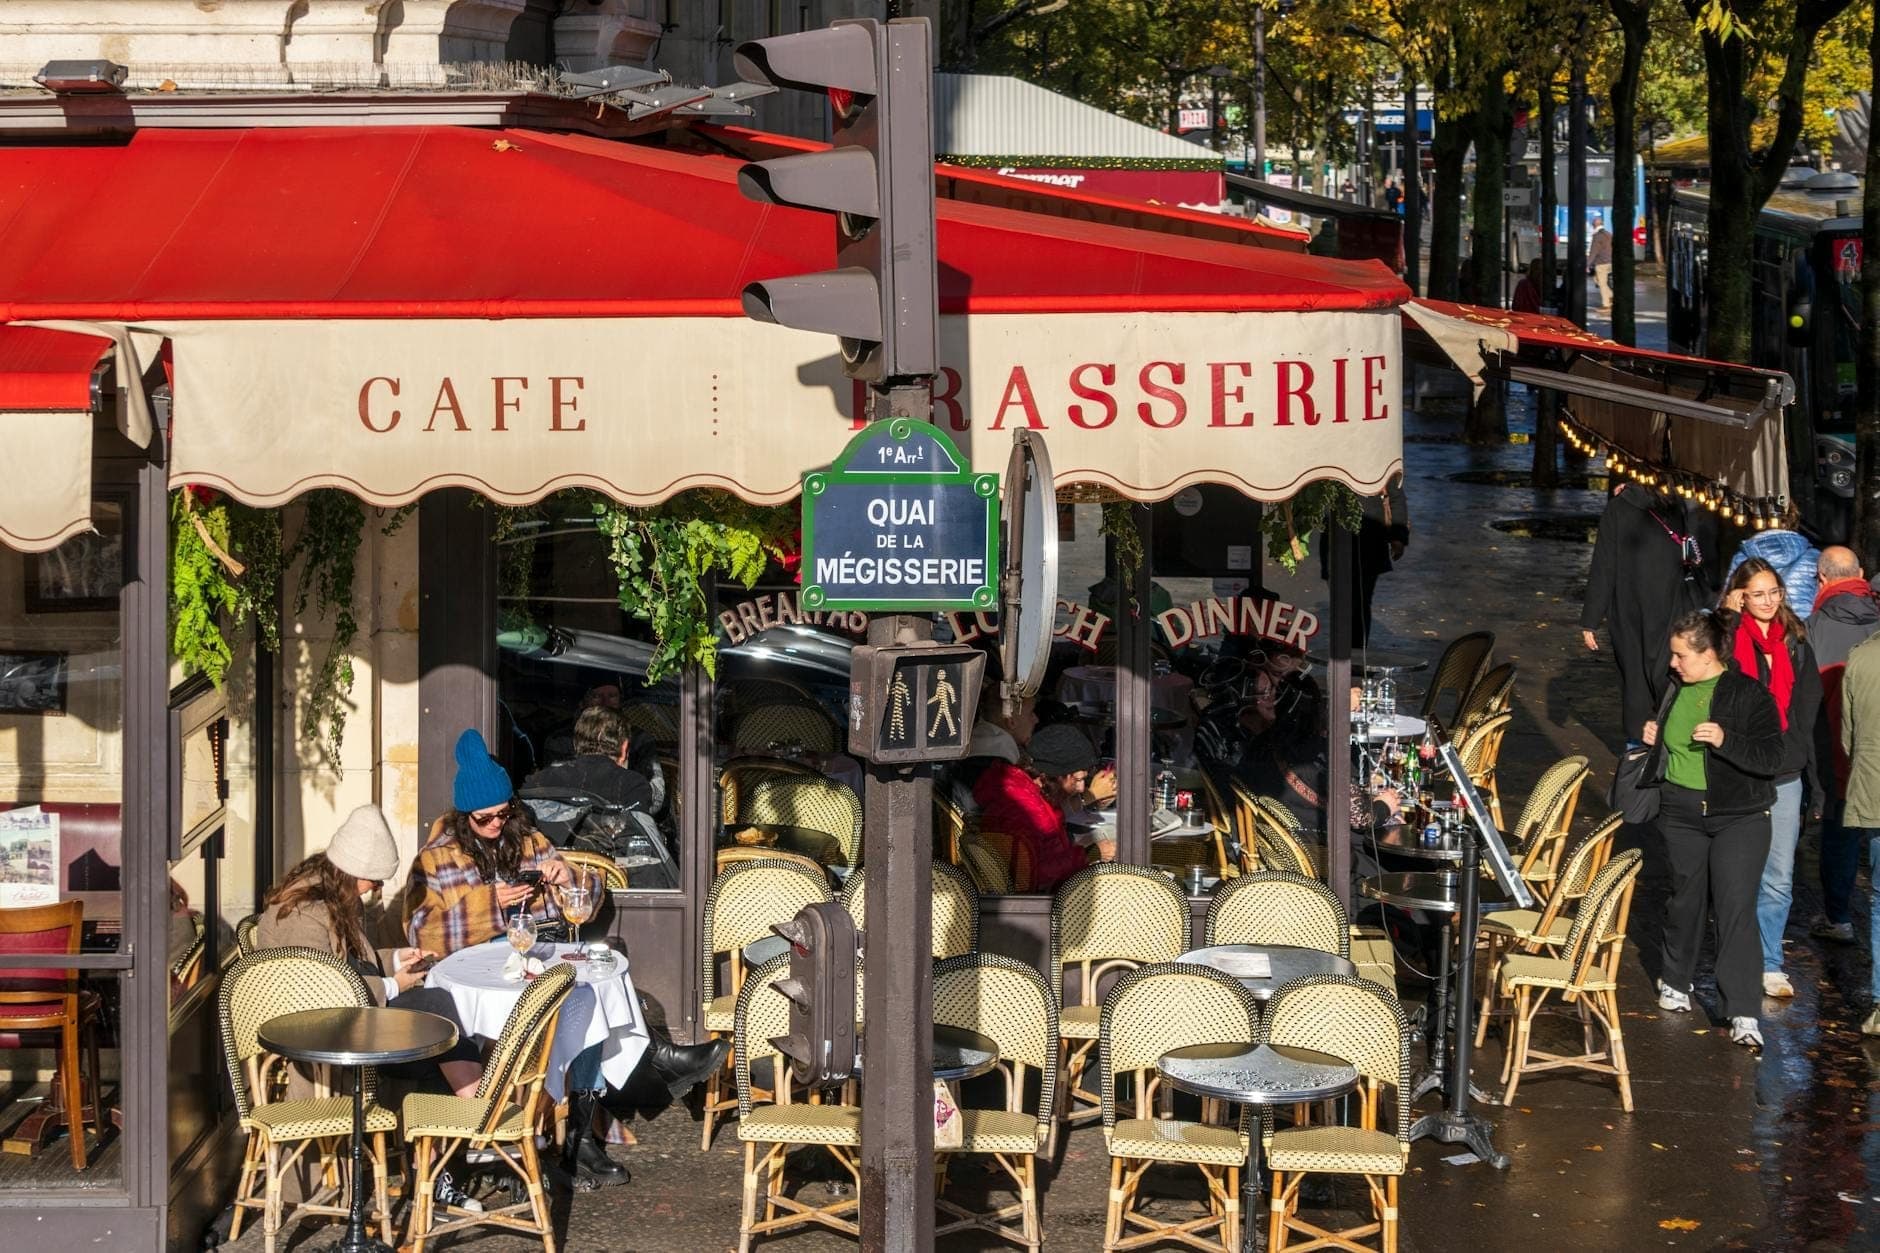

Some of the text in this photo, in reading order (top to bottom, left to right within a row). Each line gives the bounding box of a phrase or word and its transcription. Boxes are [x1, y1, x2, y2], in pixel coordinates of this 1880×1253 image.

[358, 376, 586, 433] CAFE
[867, 498, 935, 527] QUAI
[877, 535, 924, 548] DE LA
[816, 551, 984, 584] MÉGISSERIE
[1157, 596, 1321, 653] DINNER
